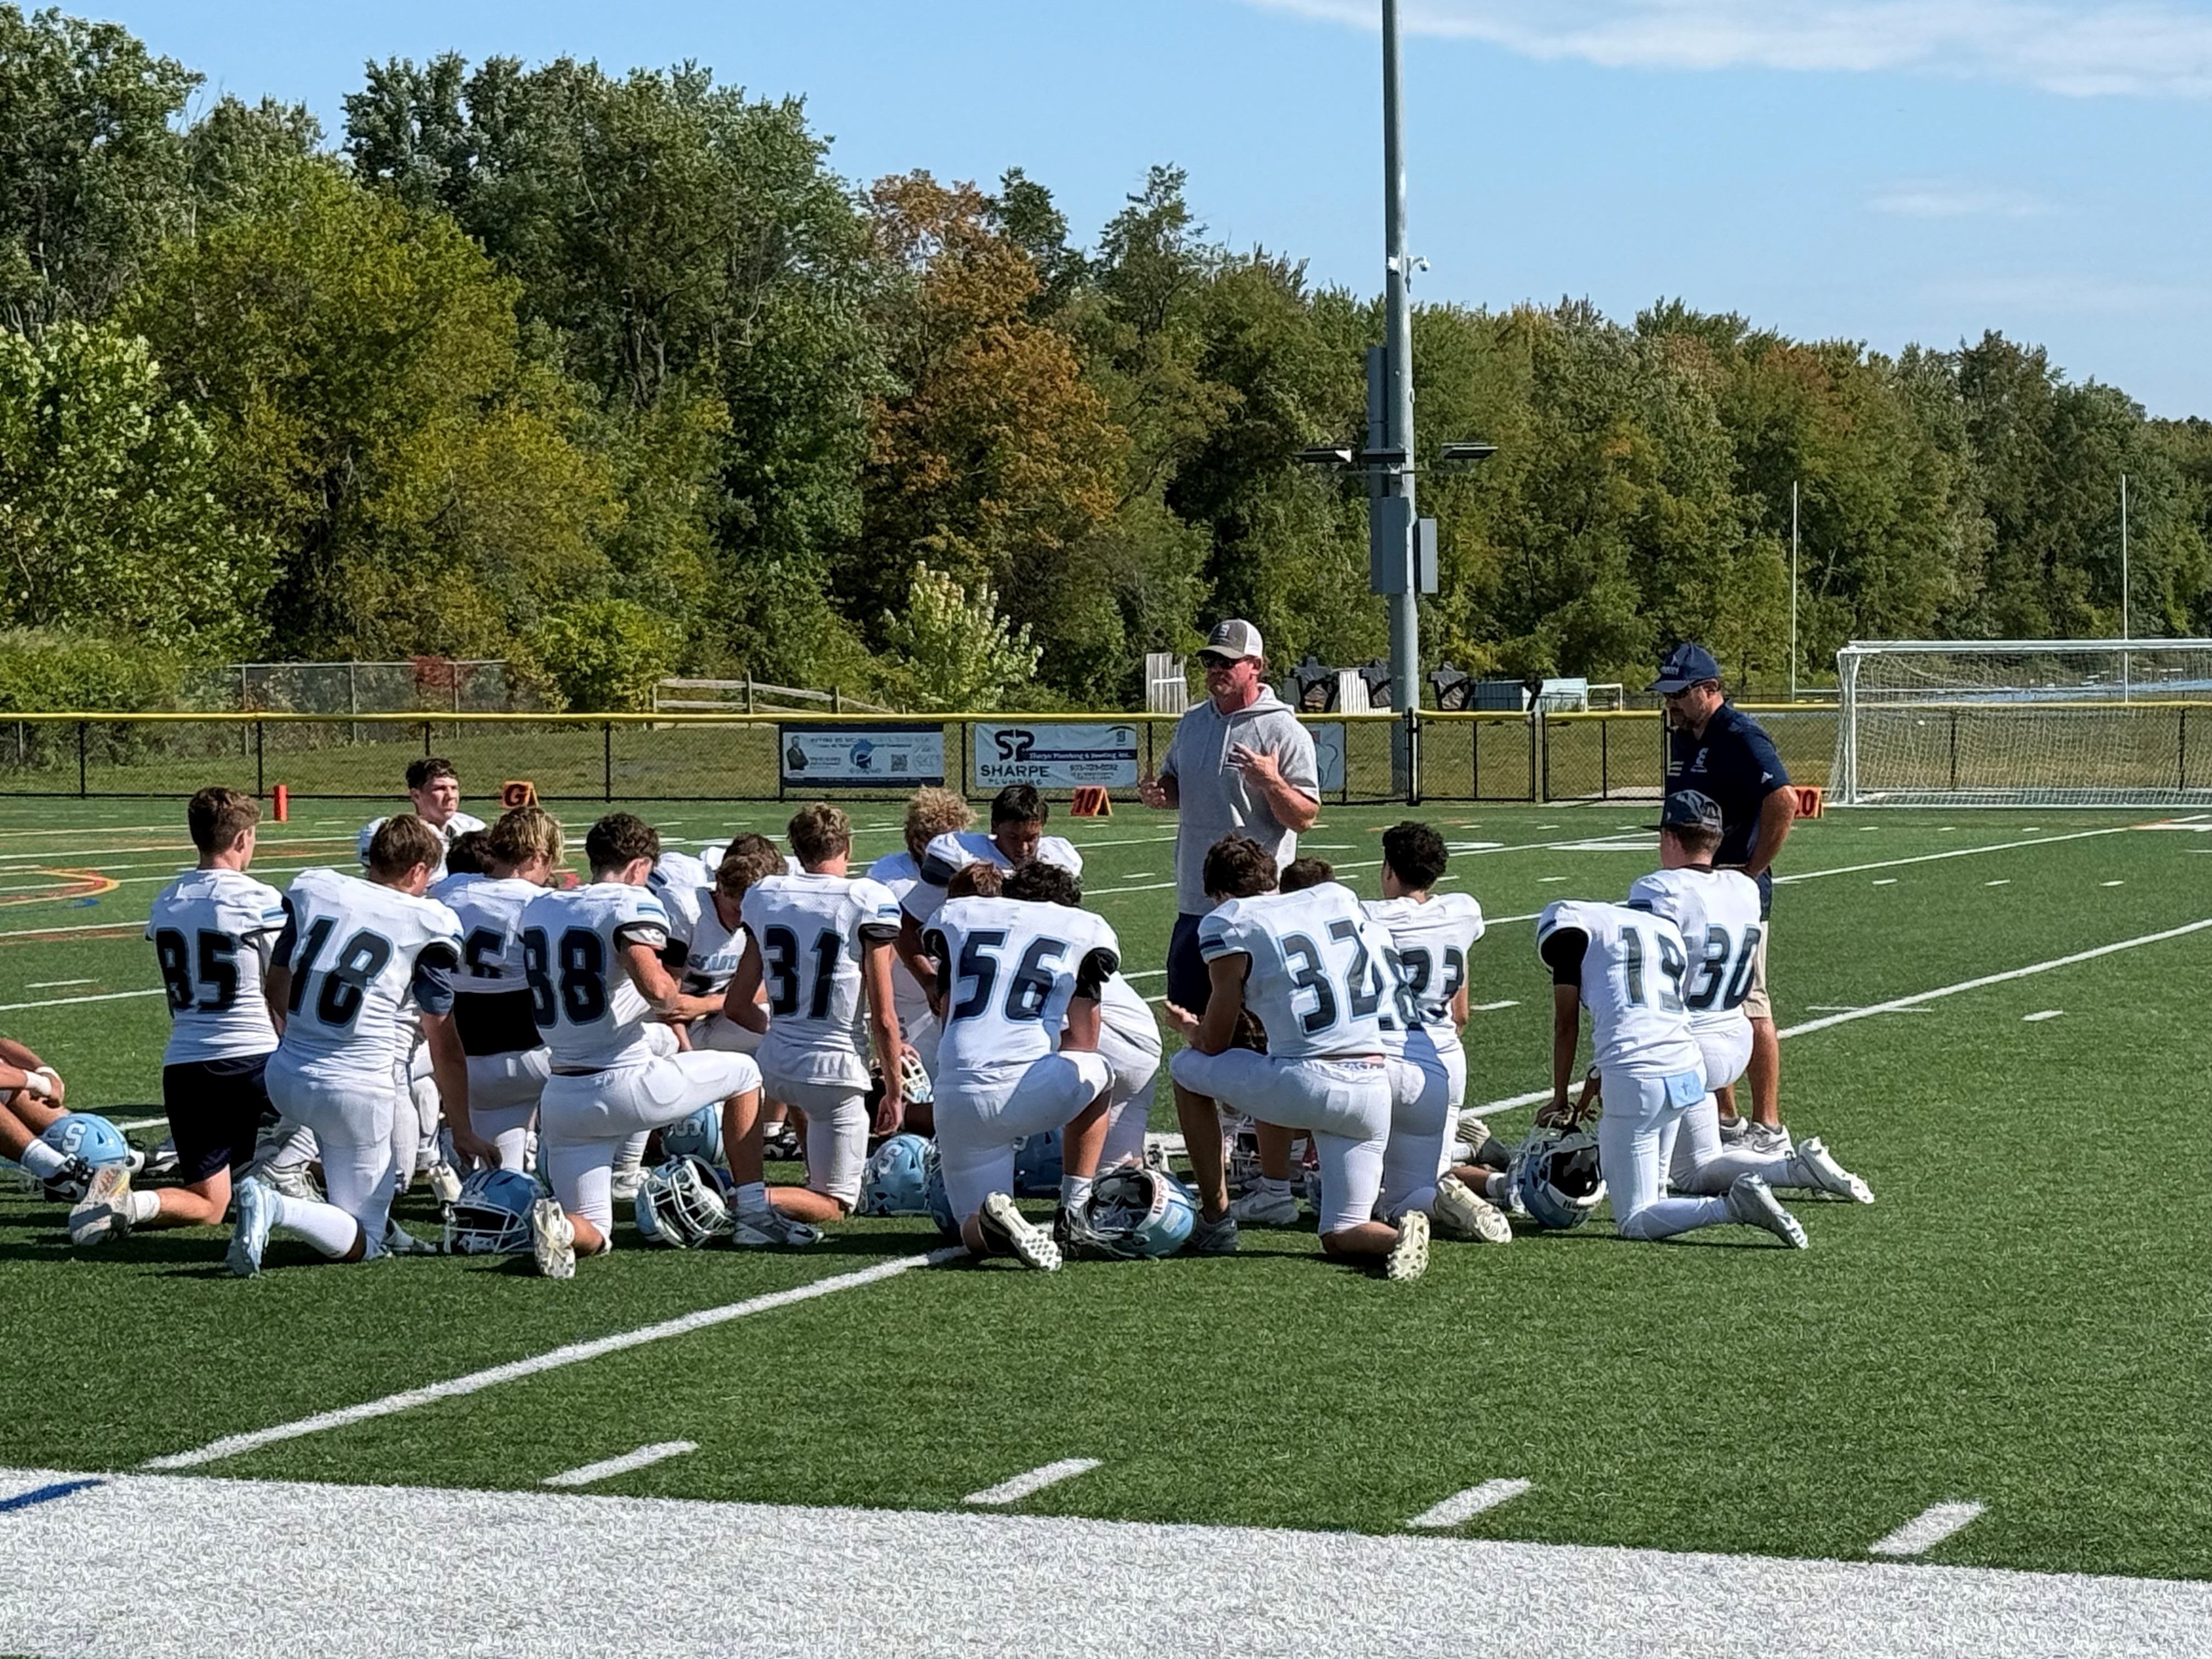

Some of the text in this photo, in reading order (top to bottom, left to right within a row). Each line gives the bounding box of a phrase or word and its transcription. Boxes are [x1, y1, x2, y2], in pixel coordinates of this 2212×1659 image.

[505, 783, 527, 807] G
[980, 764, 1050, 777] SHARPE
[1075, 788, 1098, 813] 10
[156, 927, 240, 1013] 85
[288, 915, 393, 1028] 18
[764, 924, 843, 1020] 31
[951, 928, 1070, 1024] 56
[1276, 917, 1379, 1036] 32
[62, 1122, 86, 1153] S
